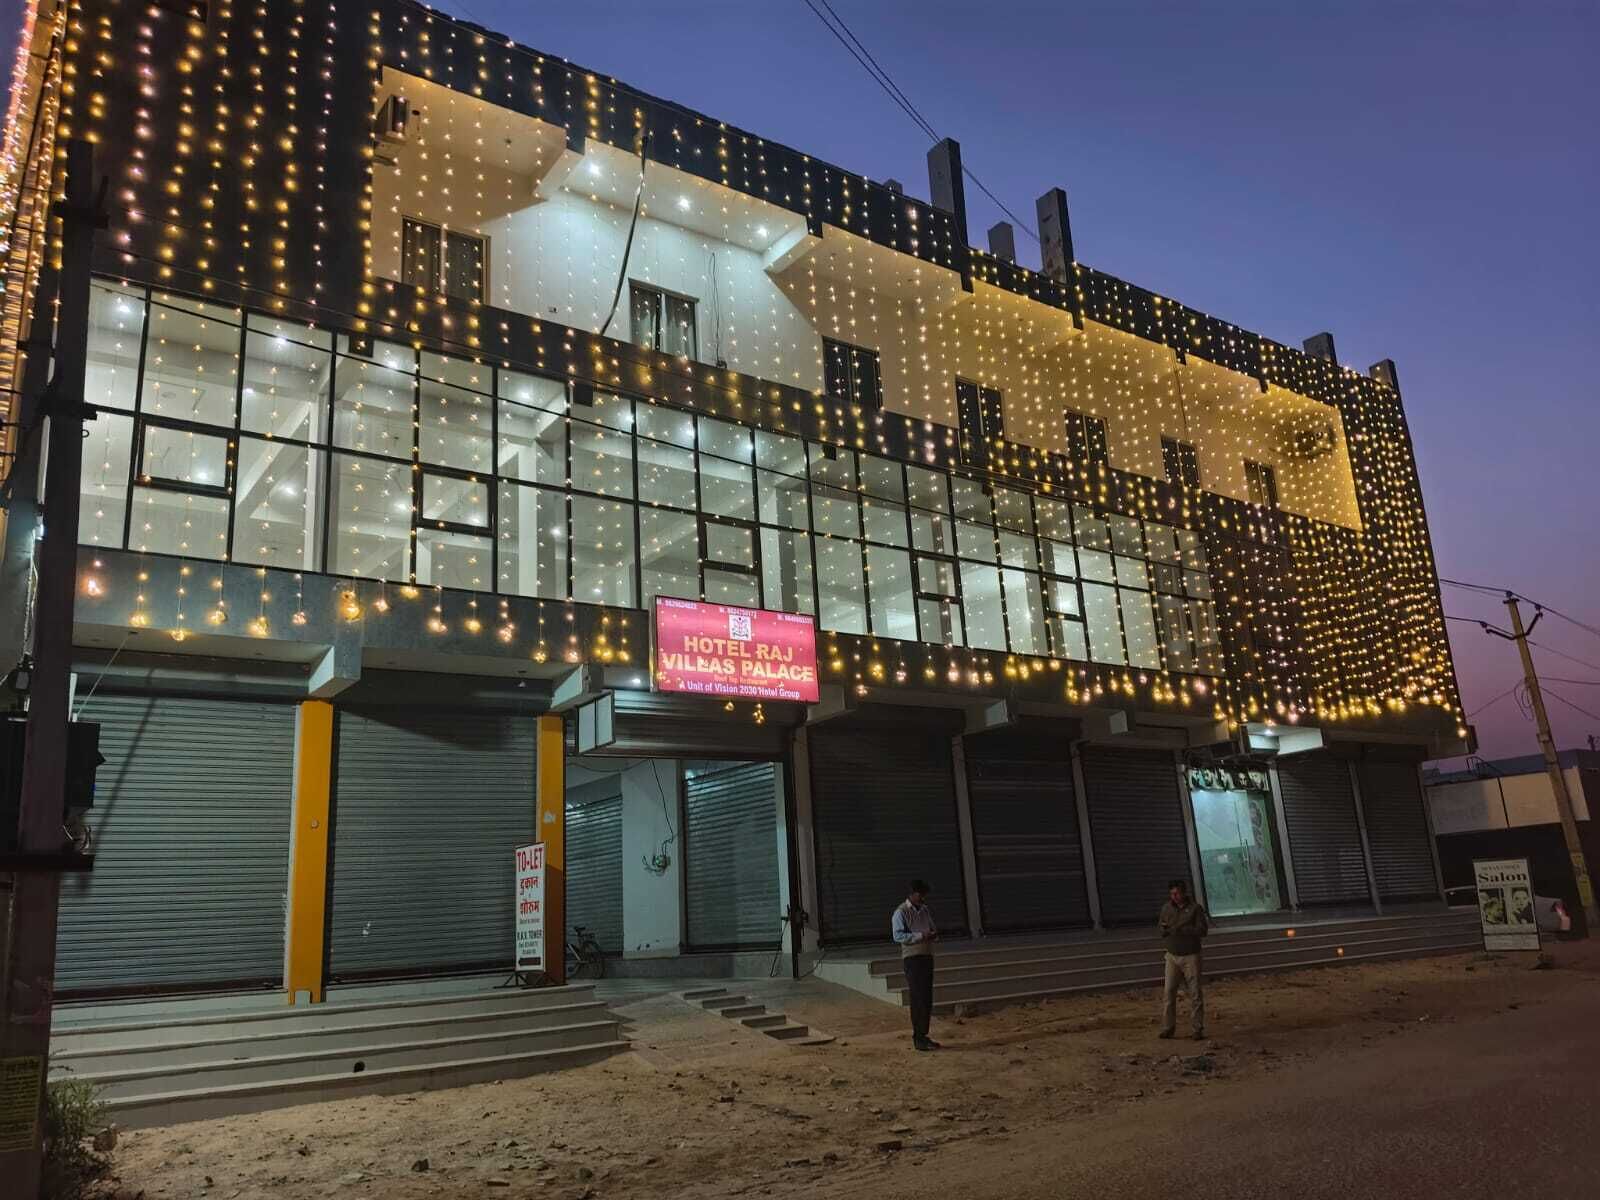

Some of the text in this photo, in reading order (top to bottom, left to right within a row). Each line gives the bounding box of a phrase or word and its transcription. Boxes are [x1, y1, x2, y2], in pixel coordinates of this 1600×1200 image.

[684, 636, 793, 663] HOTEL RAJ
[741, 660, 815, 682] PALACE
[679, 680, 801, 700] A Unit of Vision 2030 Hotel Group
[1478, 872, 1527, 883] Salon
